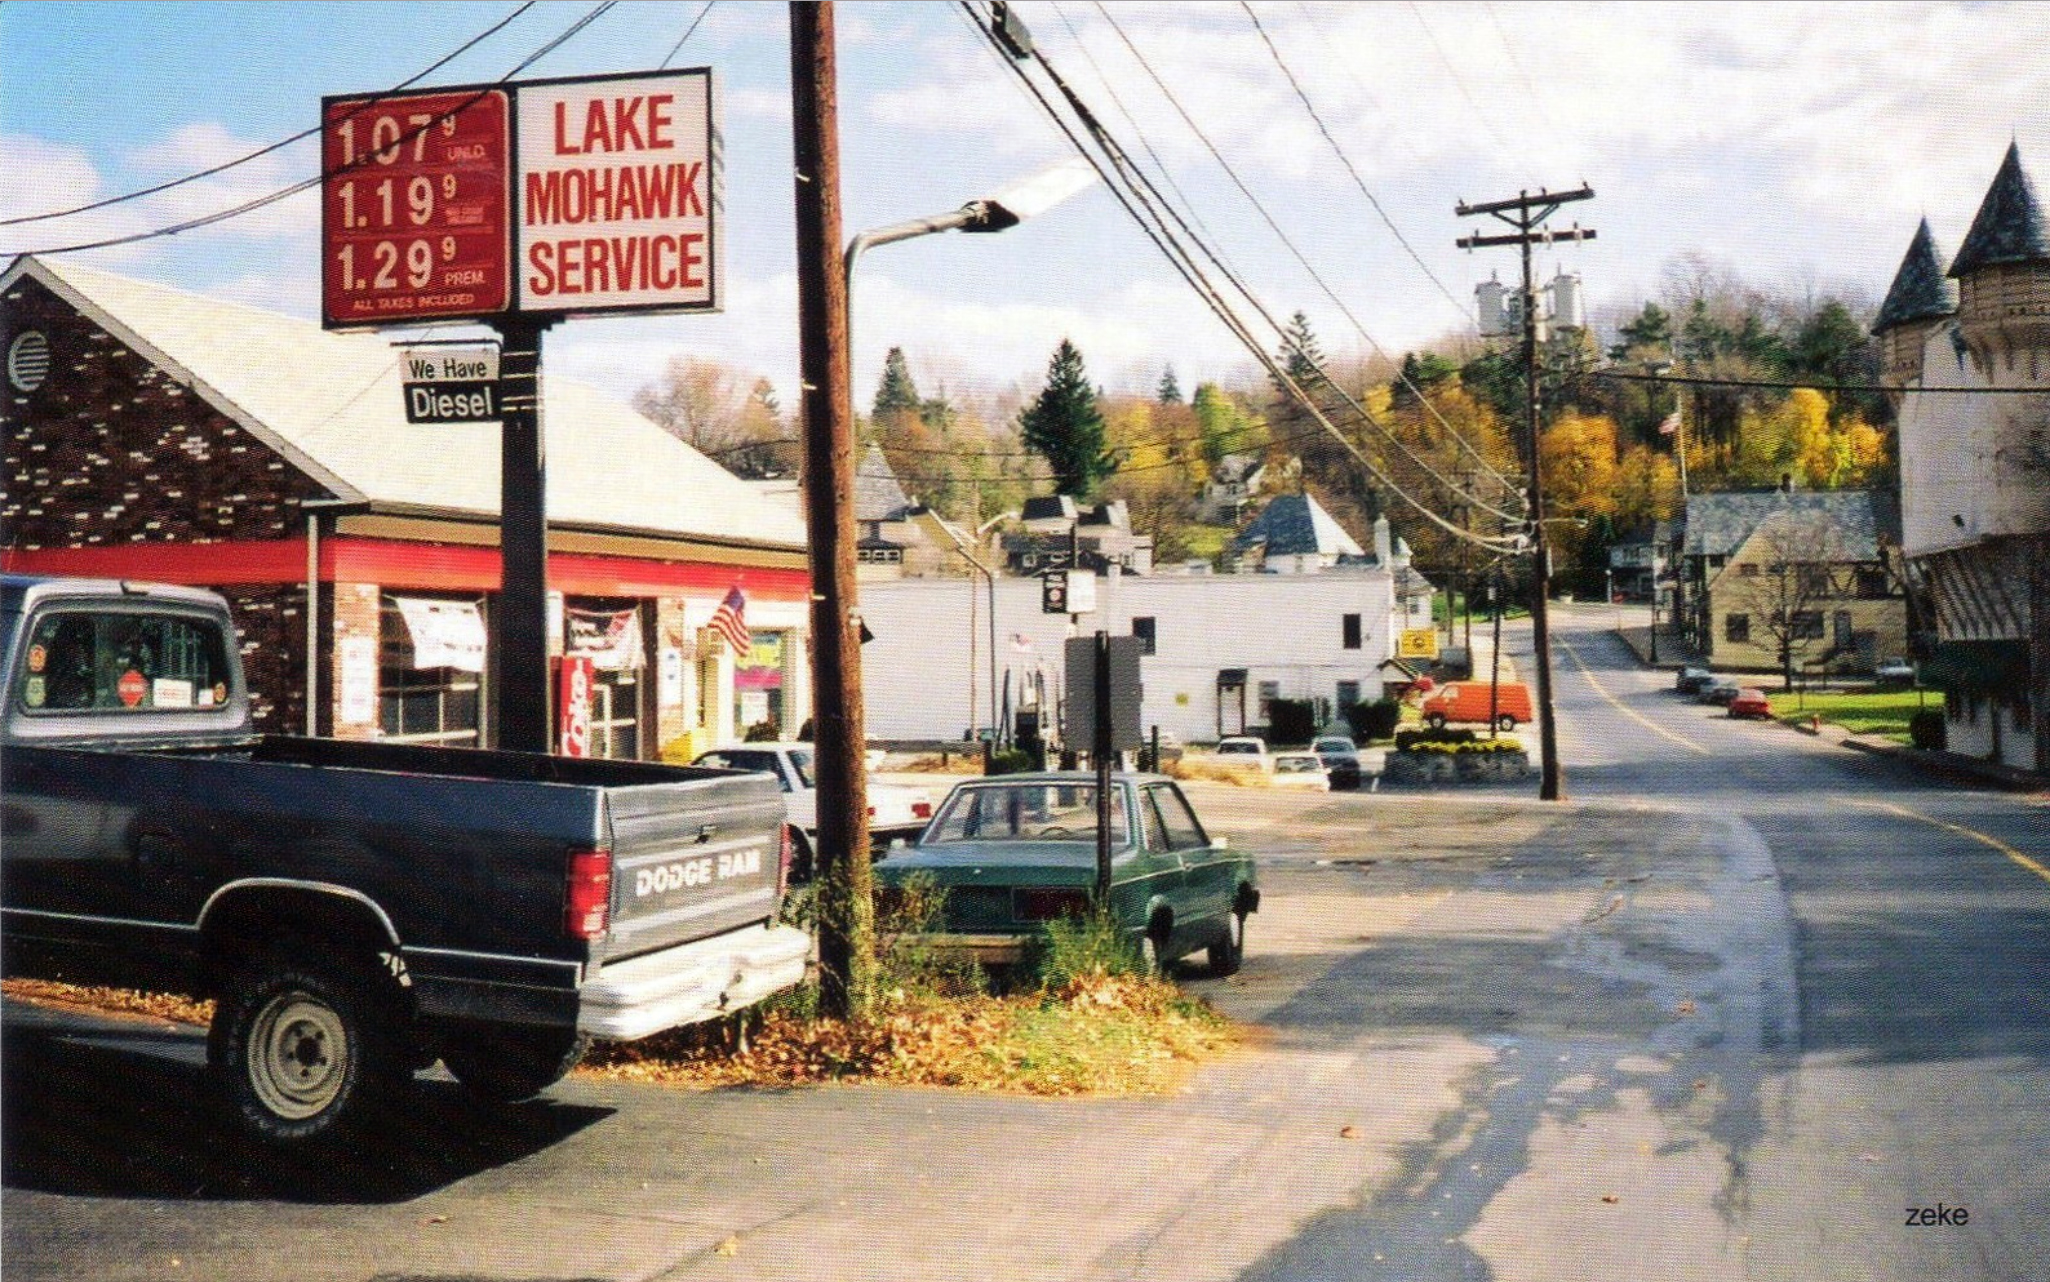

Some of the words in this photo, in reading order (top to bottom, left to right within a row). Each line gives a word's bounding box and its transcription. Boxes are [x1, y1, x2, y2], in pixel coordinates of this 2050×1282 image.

[554, 94, 675, 156] LAKE
[337, 176, 434, 228] 1.19
[526, 162, 704, 226] MOHAWK
[337, 239, 433, 290] 1.29
[529, 233, 704, 297] SERVICE
[352, 299, 375, 312] ALL
[377, 296, 414, 310] TAXES
[417, 293, 476, 308] INCLUDED
[409, 359, 435, 379] We
[442, 358, 488, 378] Have
[411, 386, 493, 419] Diesel
[636, 858, 713, 897] DODGE
[717, 848, 761, 881] RAM
